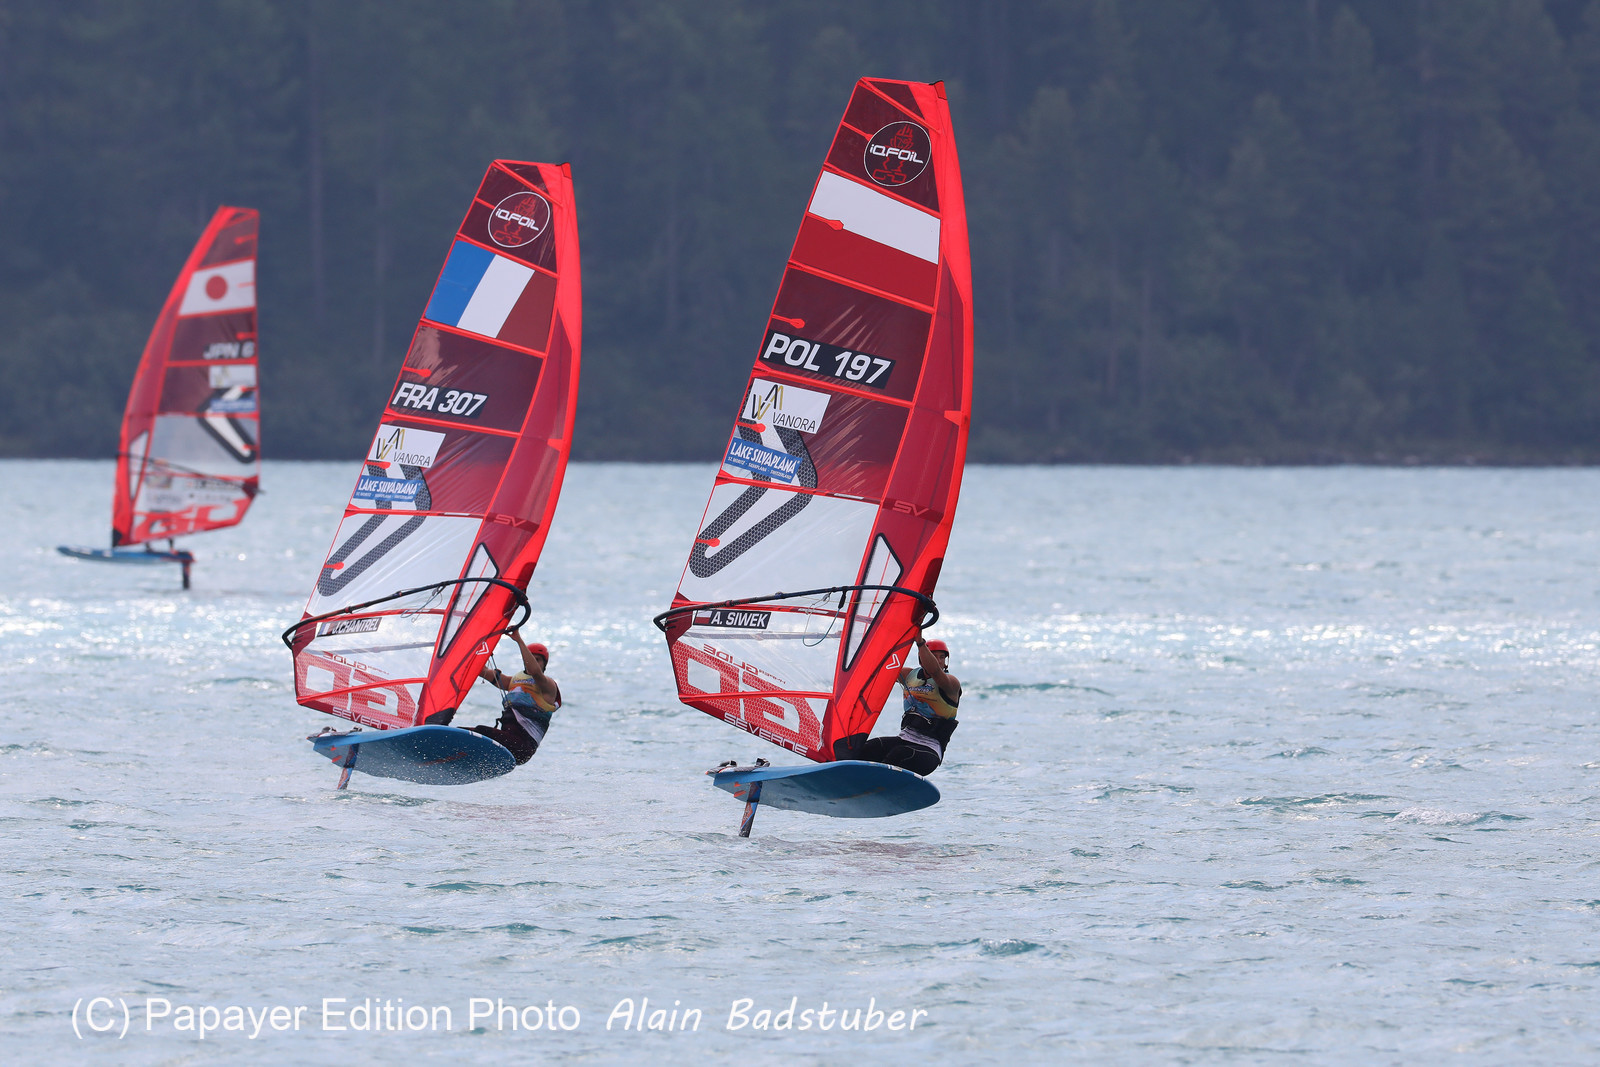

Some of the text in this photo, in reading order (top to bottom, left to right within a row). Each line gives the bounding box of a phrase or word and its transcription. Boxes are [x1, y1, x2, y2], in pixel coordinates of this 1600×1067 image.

[763, 332, 892, 384] POL 197
[392, 381, 488, 417] FRA 307
[772, 411, 817, 432] VANORA
[393, 451, 431, 467] VANORA
[730, 441, 798, 474] LAKE SILVAPLANA
[358, 478, 379, 492] LAKE
[711, 611, 770, 628] A. SIWEK
[724, 713, 808, 757] SEVERNE
